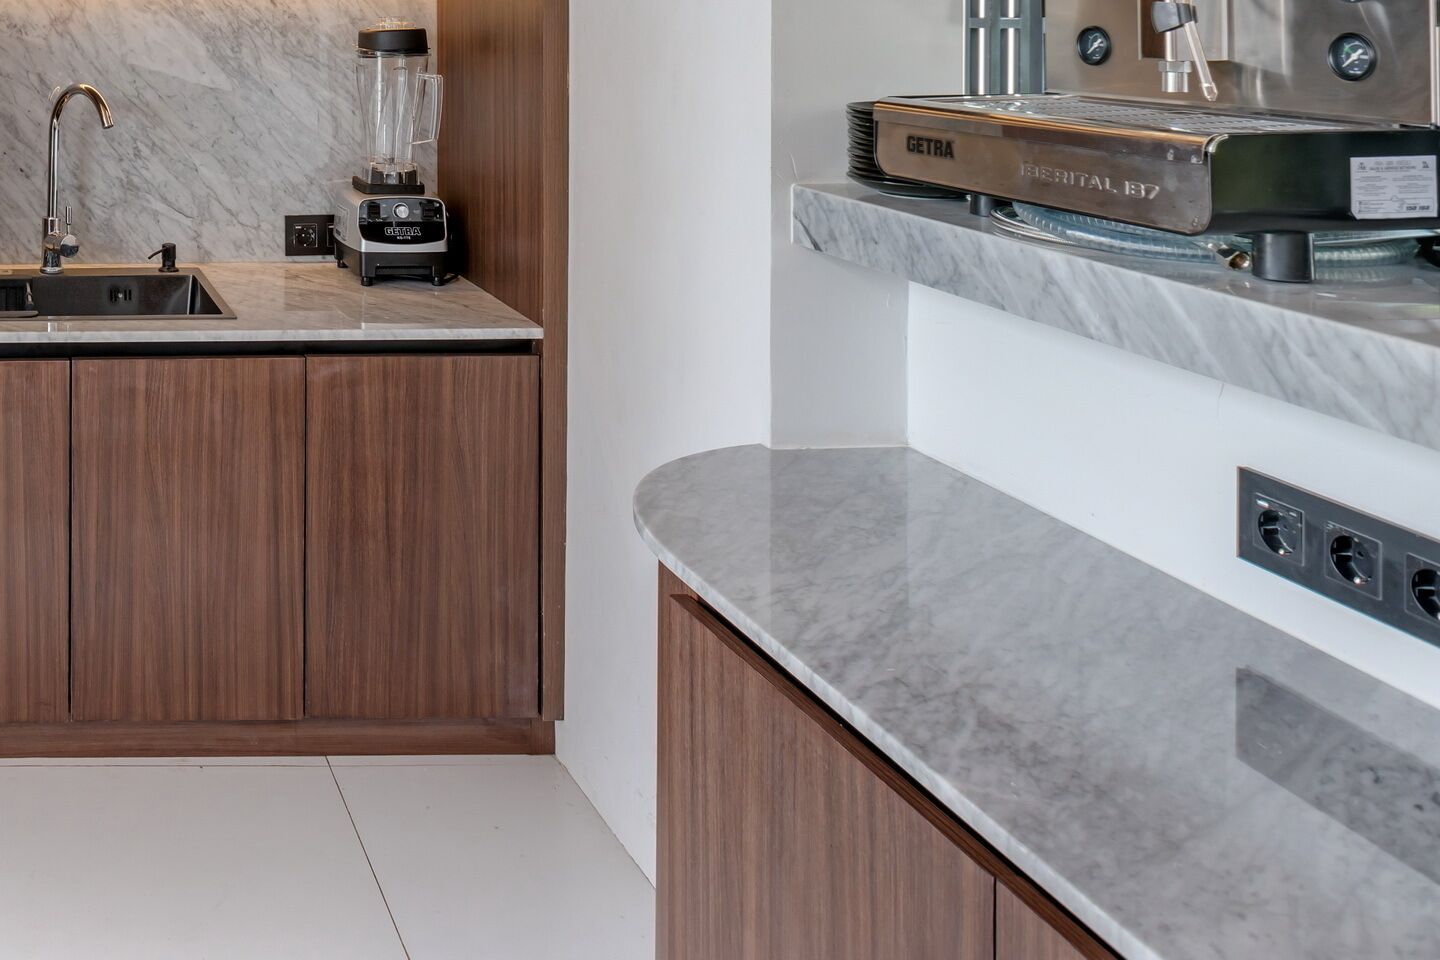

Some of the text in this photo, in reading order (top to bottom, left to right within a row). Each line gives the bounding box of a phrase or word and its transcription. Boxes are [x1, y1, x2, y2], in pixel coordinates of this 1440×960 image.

[906, 135, 955, 159] GETRA
[1020, 162, 1118, 194] IBERITAL
[384, 226, 422, 236] GETRA
